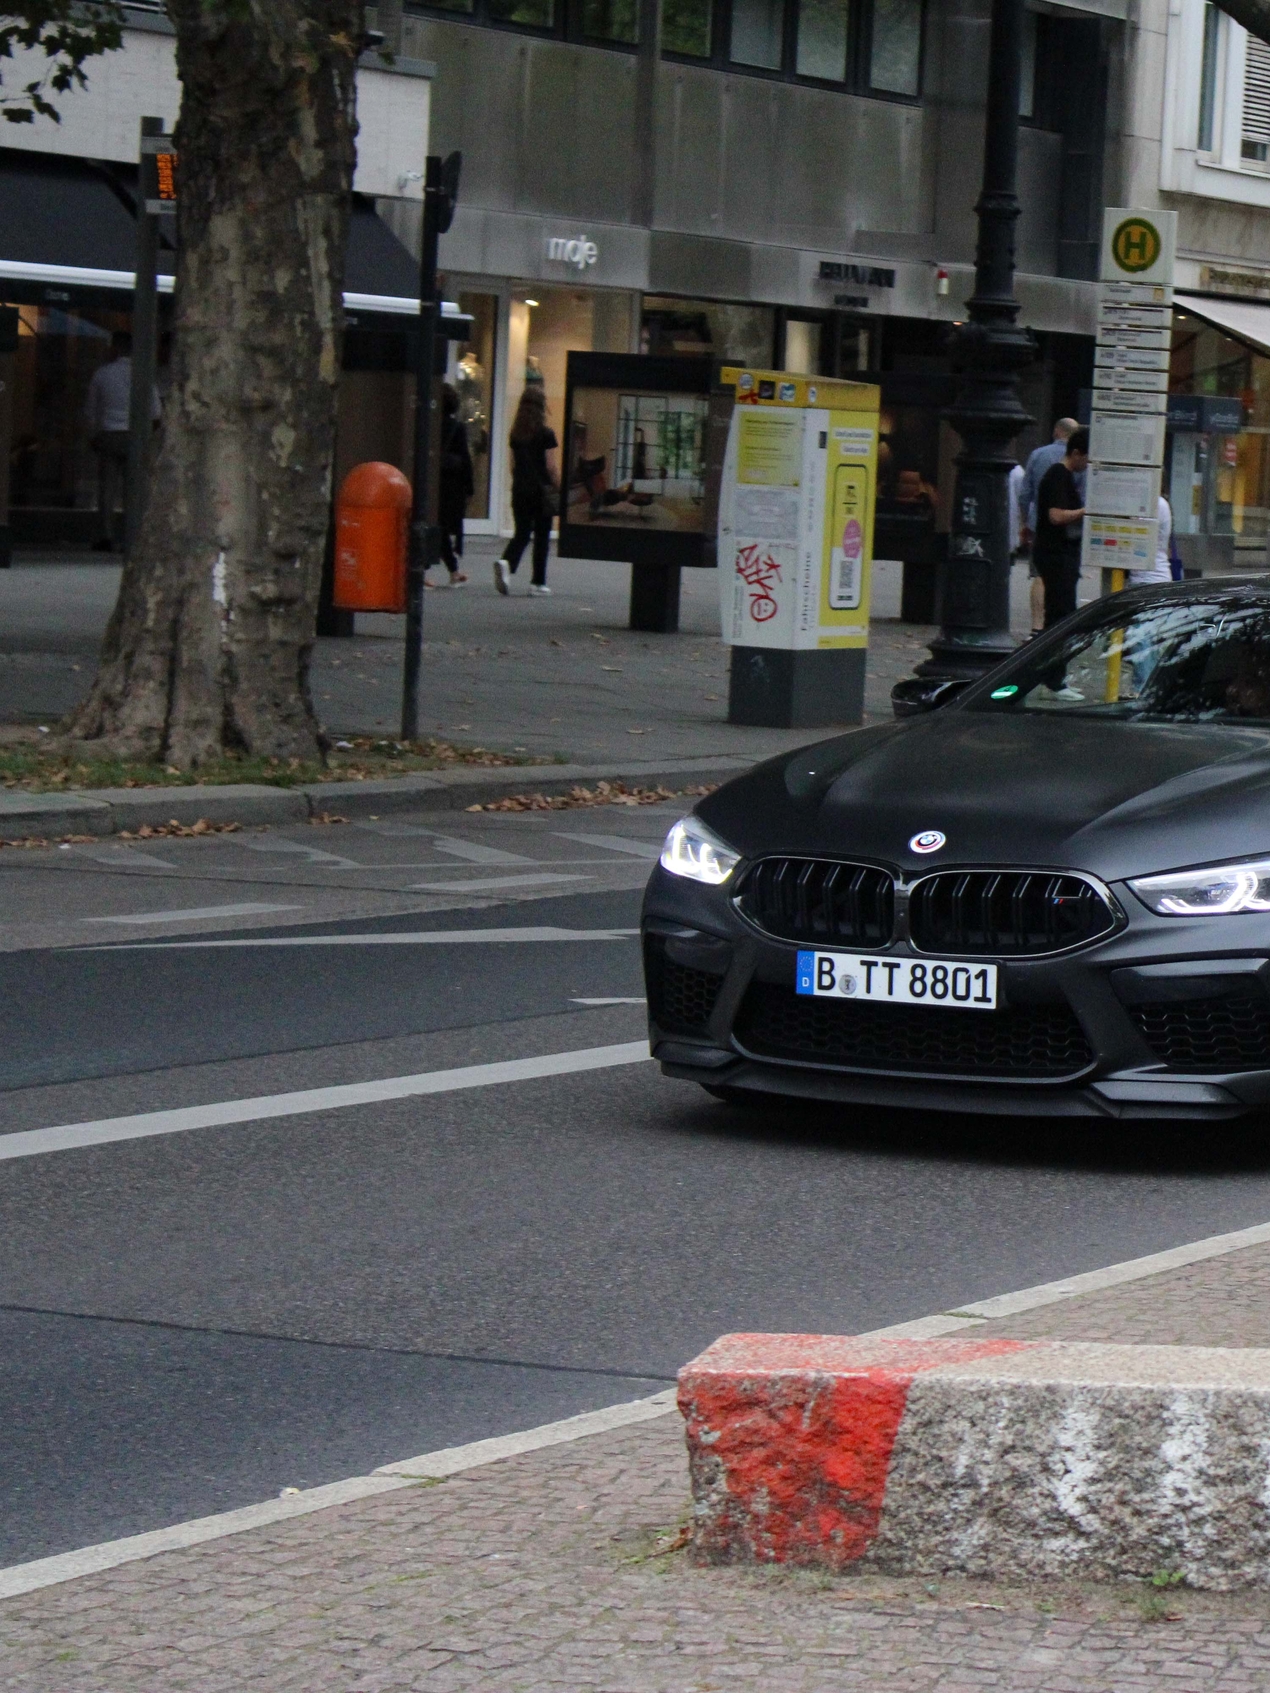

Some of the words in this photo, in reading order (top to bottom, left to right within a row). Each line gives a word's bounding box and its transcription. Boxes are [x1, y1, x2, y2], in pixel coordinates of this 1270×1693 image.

[548, 234, 598, 270] maje
[816, 957, 836, 991] B
[859, 960, 901, 996] TT
[908, 963, 993, 1004] 8801
